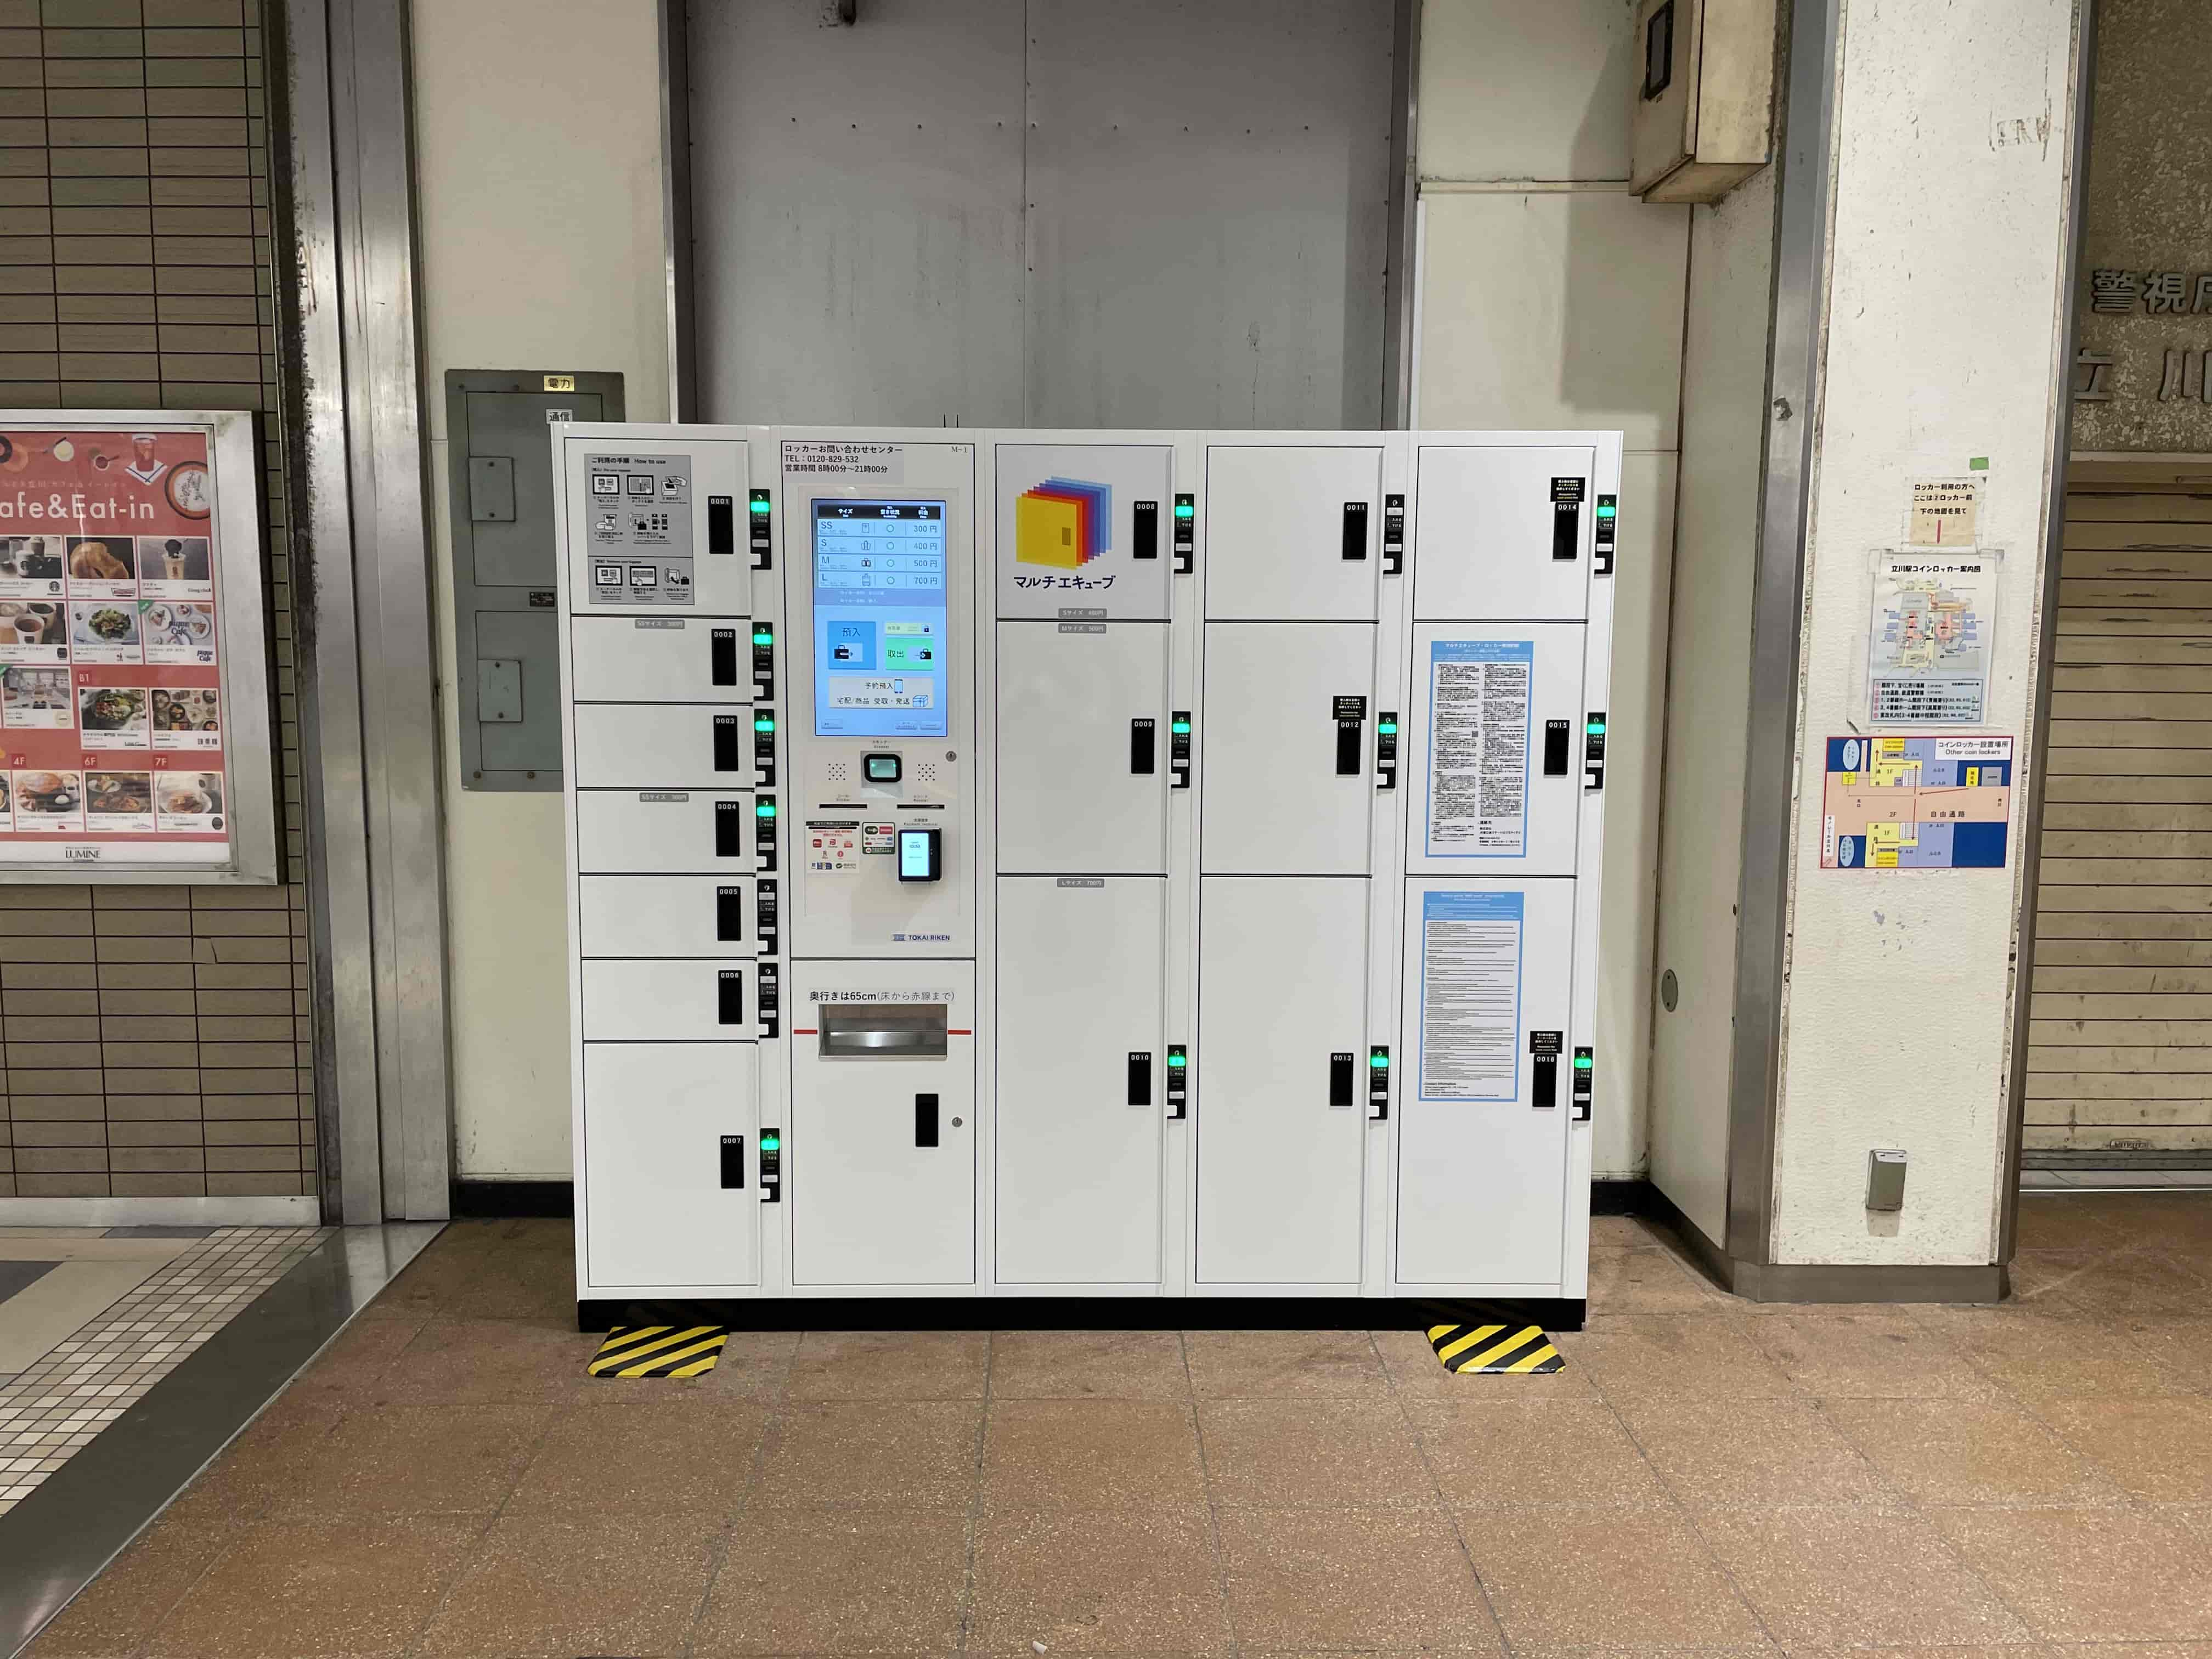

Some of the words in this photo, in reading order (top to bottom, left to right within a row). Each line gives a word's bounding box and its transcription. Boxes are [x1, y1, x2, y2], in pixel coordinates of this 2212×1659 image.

[548, 377, 571, 388] 電力
[549, 412, 569, 421] 通信
[785, 445, 902, 454] ロッカーお問い合わせセンター
[1013, 575, 1116, 589] マルチエキューブ
[842, 627, 861, 637] 預入
[887, 650, 904, 658] 取出
[79, 674, 89, 682] B1
[65, 849, 101, 859] LUMINE
[809, 991, 955, 1001] 奥行きは65cm(床から赤線まで)
